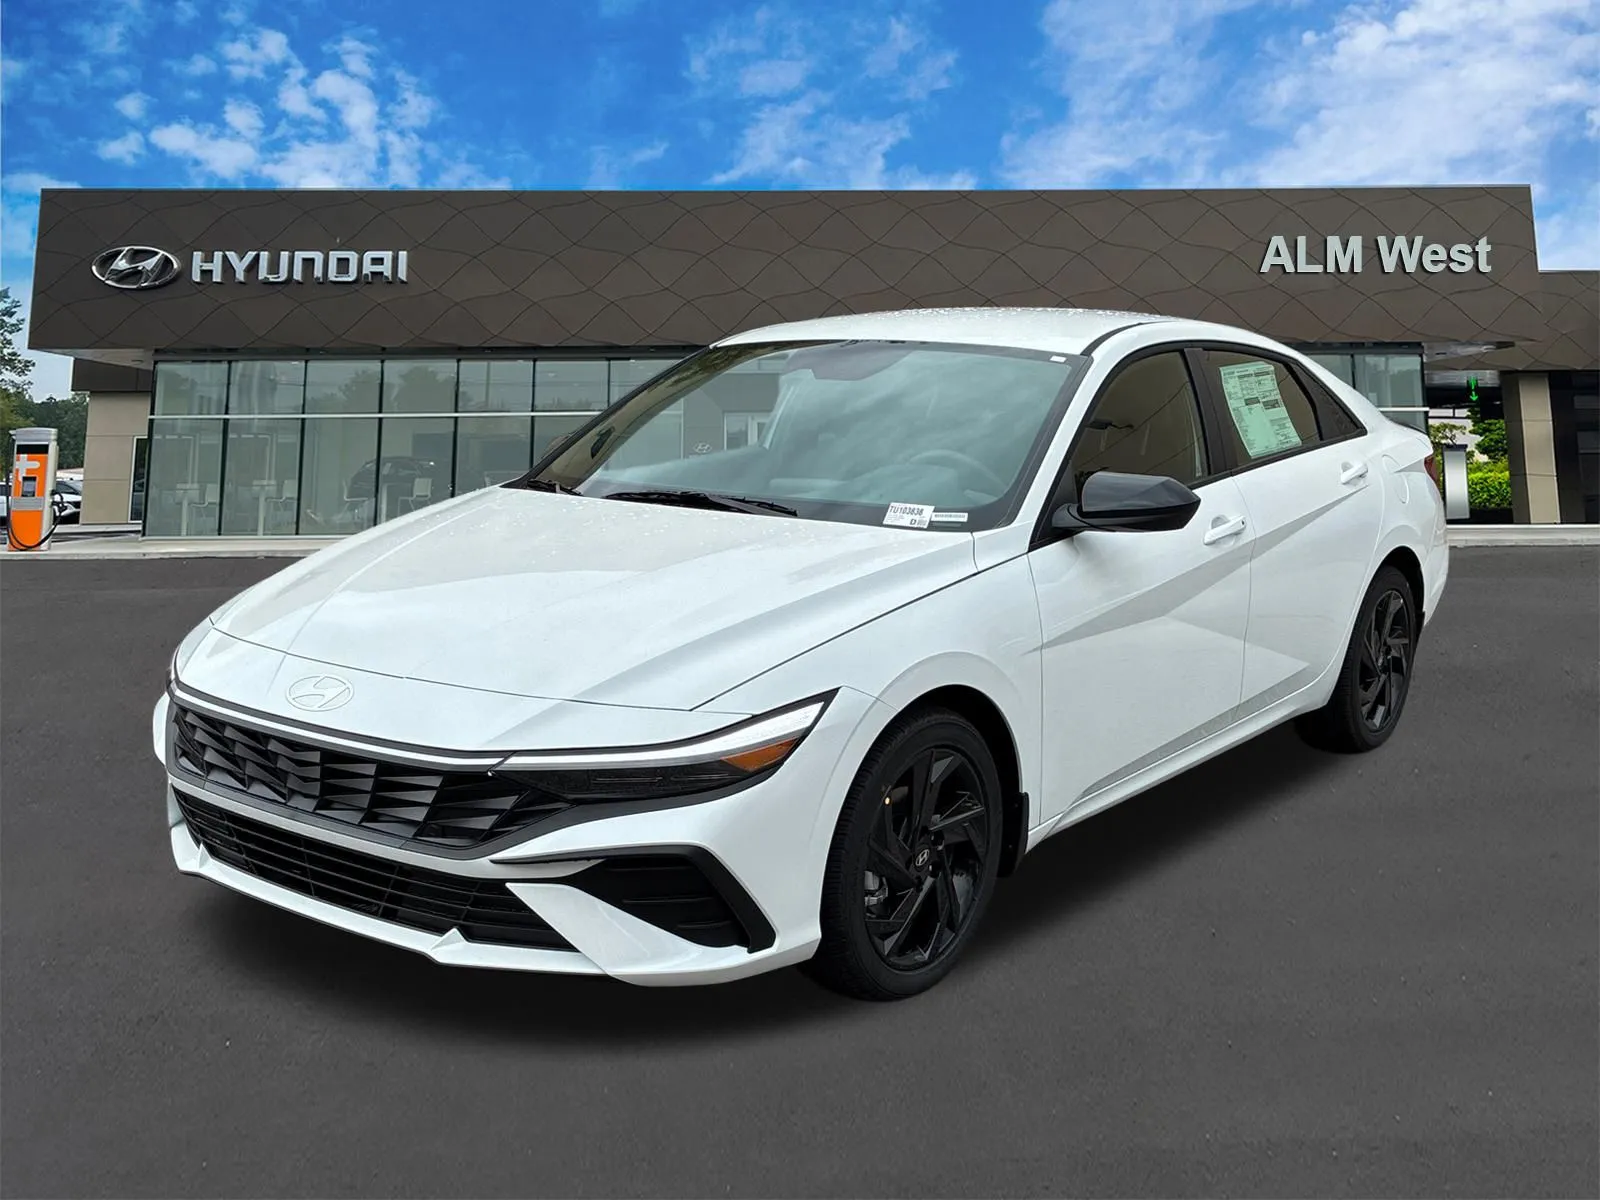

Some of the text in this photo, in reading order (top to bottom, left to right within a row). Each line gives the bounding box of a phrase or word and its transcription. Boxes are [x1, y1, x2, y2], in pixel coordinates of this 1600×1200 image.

[191, 250, 408, 283] HYUNDAI
[1259, 235, 1492, 273] ALM West
